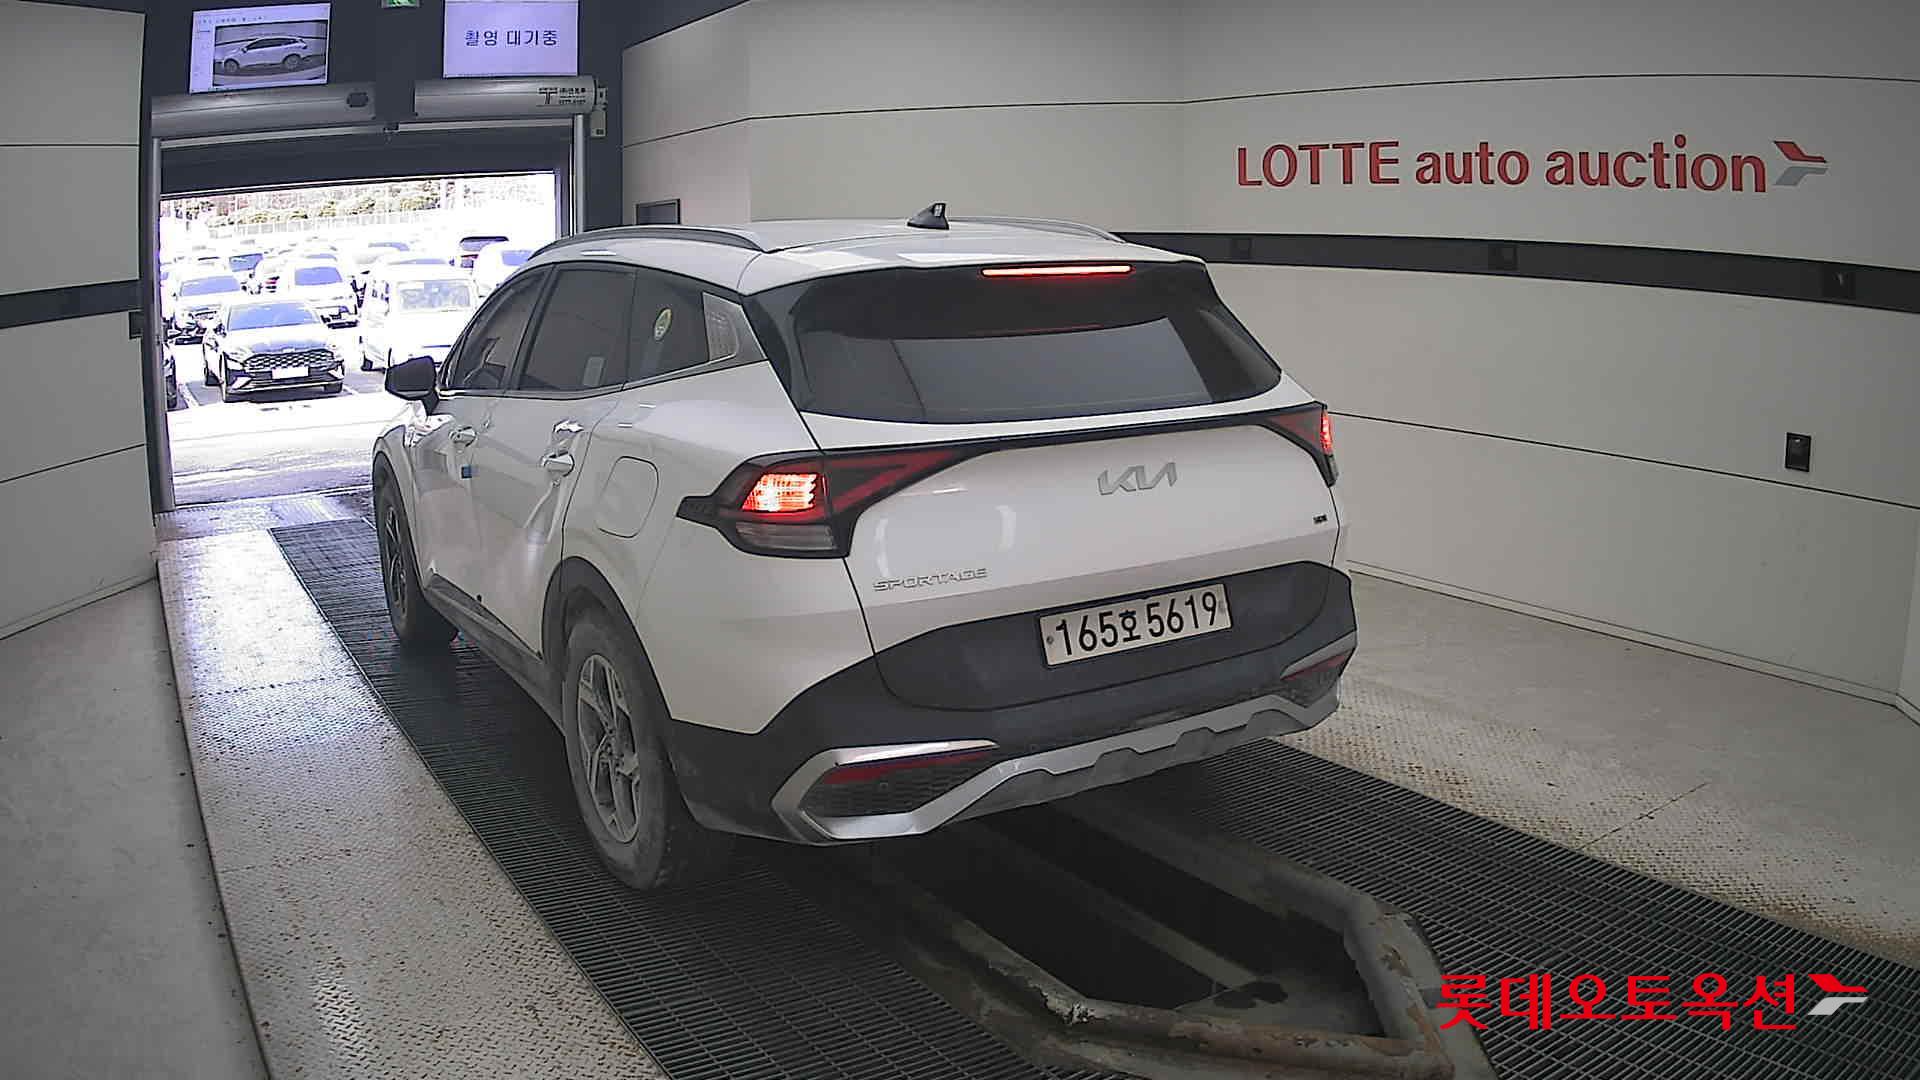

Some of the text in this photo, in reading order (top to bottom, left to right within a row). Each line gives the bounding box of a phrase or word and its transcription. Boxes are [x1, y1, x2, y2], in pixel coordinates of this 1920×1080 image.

[465, 30, 557, 46] 촬영 대기중
[1237, 135, 1766, 192] LOTTE auto auction
[873, 568, 987, 592] SPORTAGE
[1146, 591, 1217, 638] 5619
